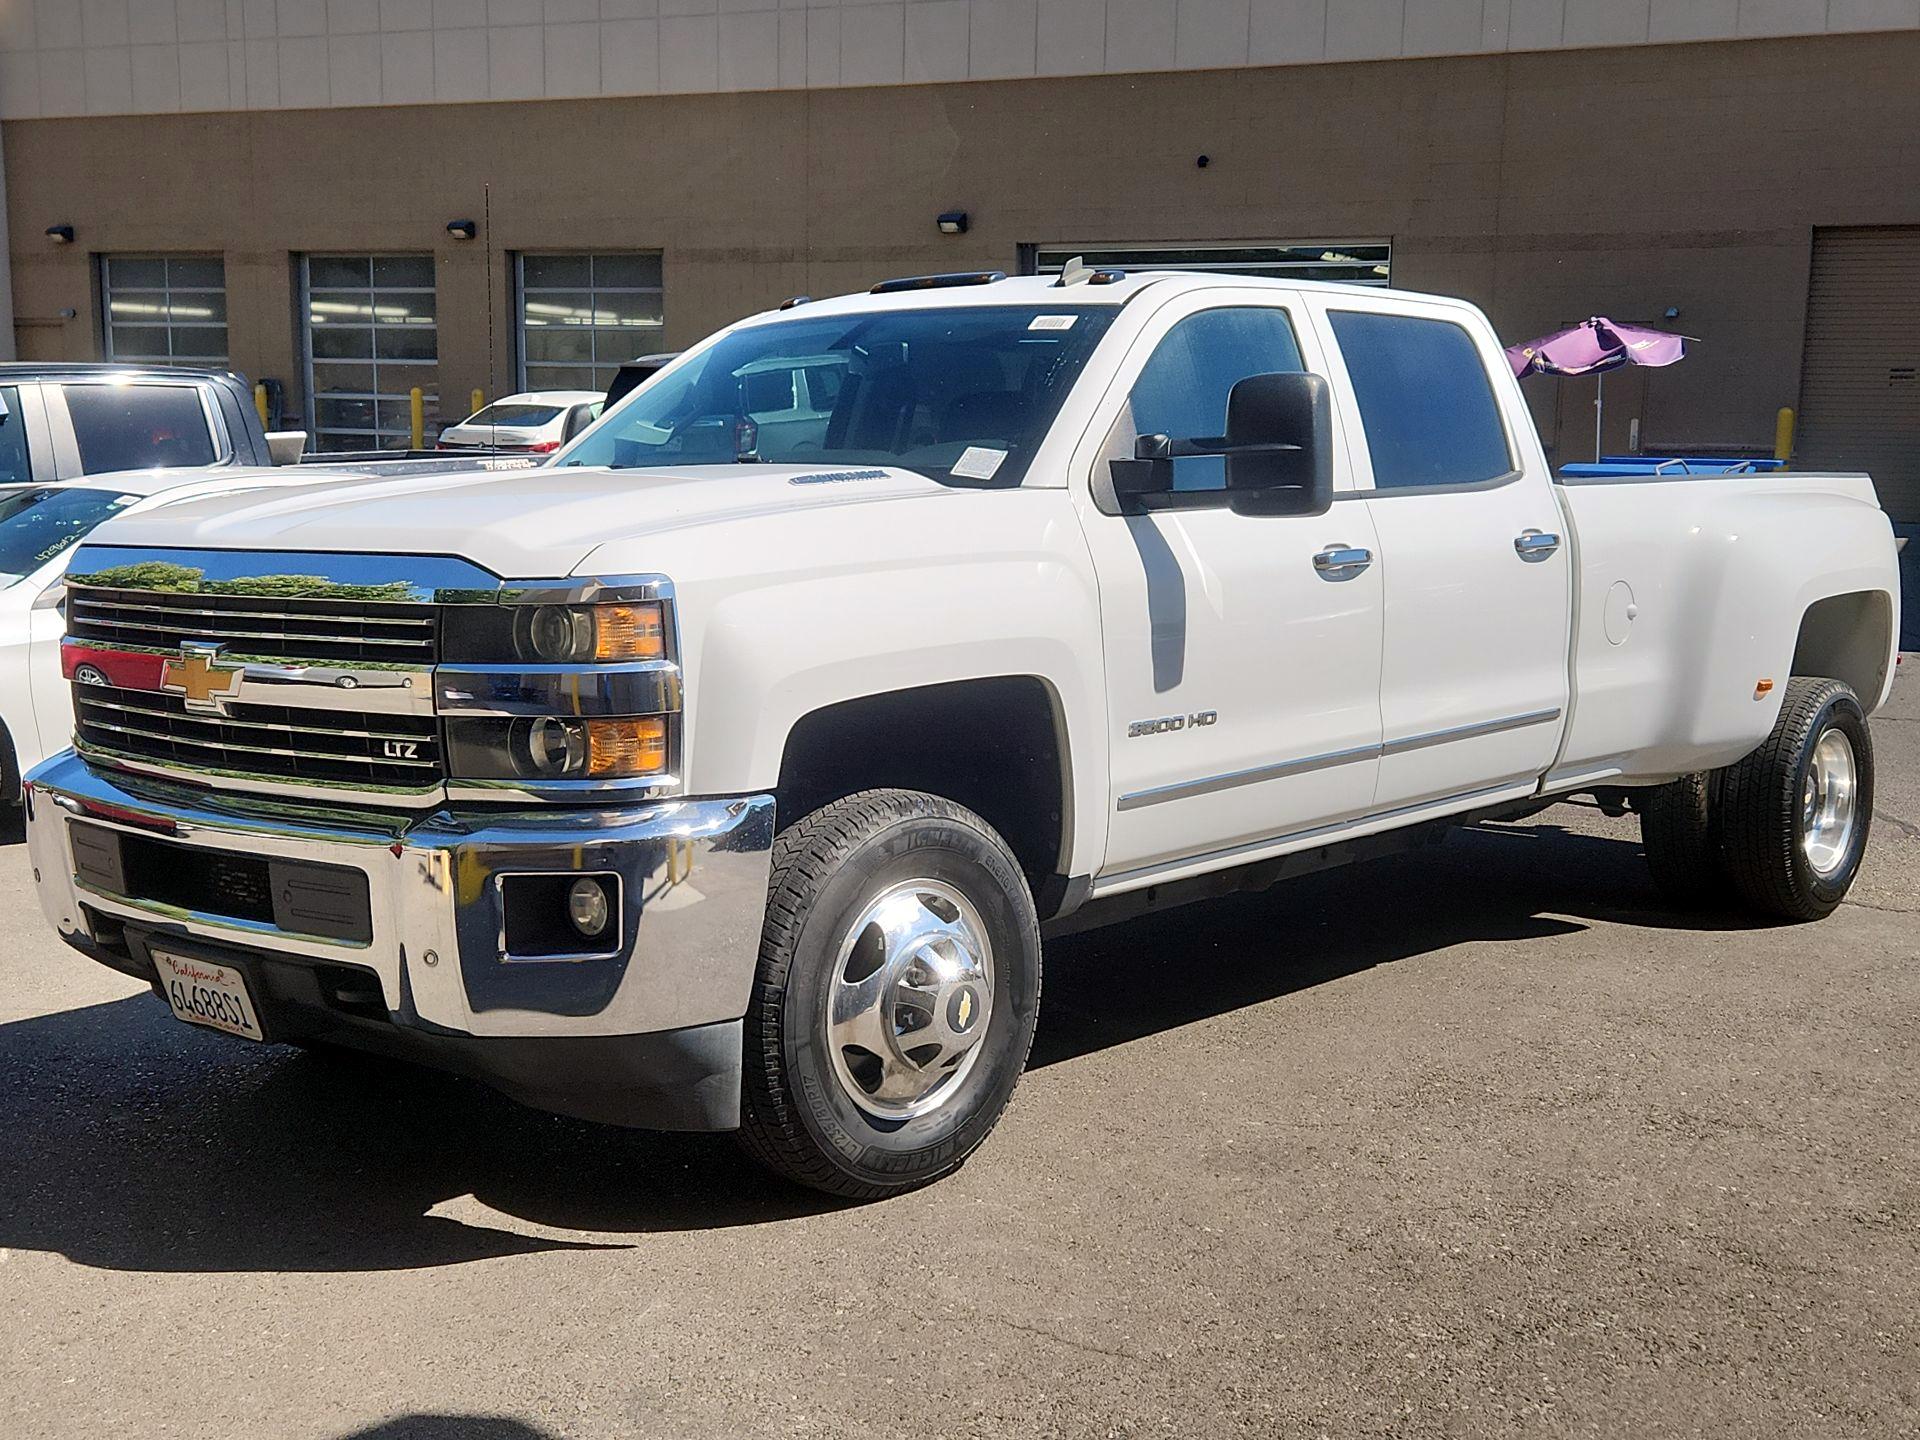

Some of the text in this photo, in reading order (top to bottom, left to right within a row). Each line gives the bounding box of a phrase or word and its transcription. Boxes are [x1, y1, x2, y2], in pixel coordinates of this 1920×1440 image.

[1127, 709, 1217, 738] 3500 HD
[384, 740, 418, 759] LTZ
[171, 957, 223, 983] California
[170, 980, 252, 1030] 64688S1
